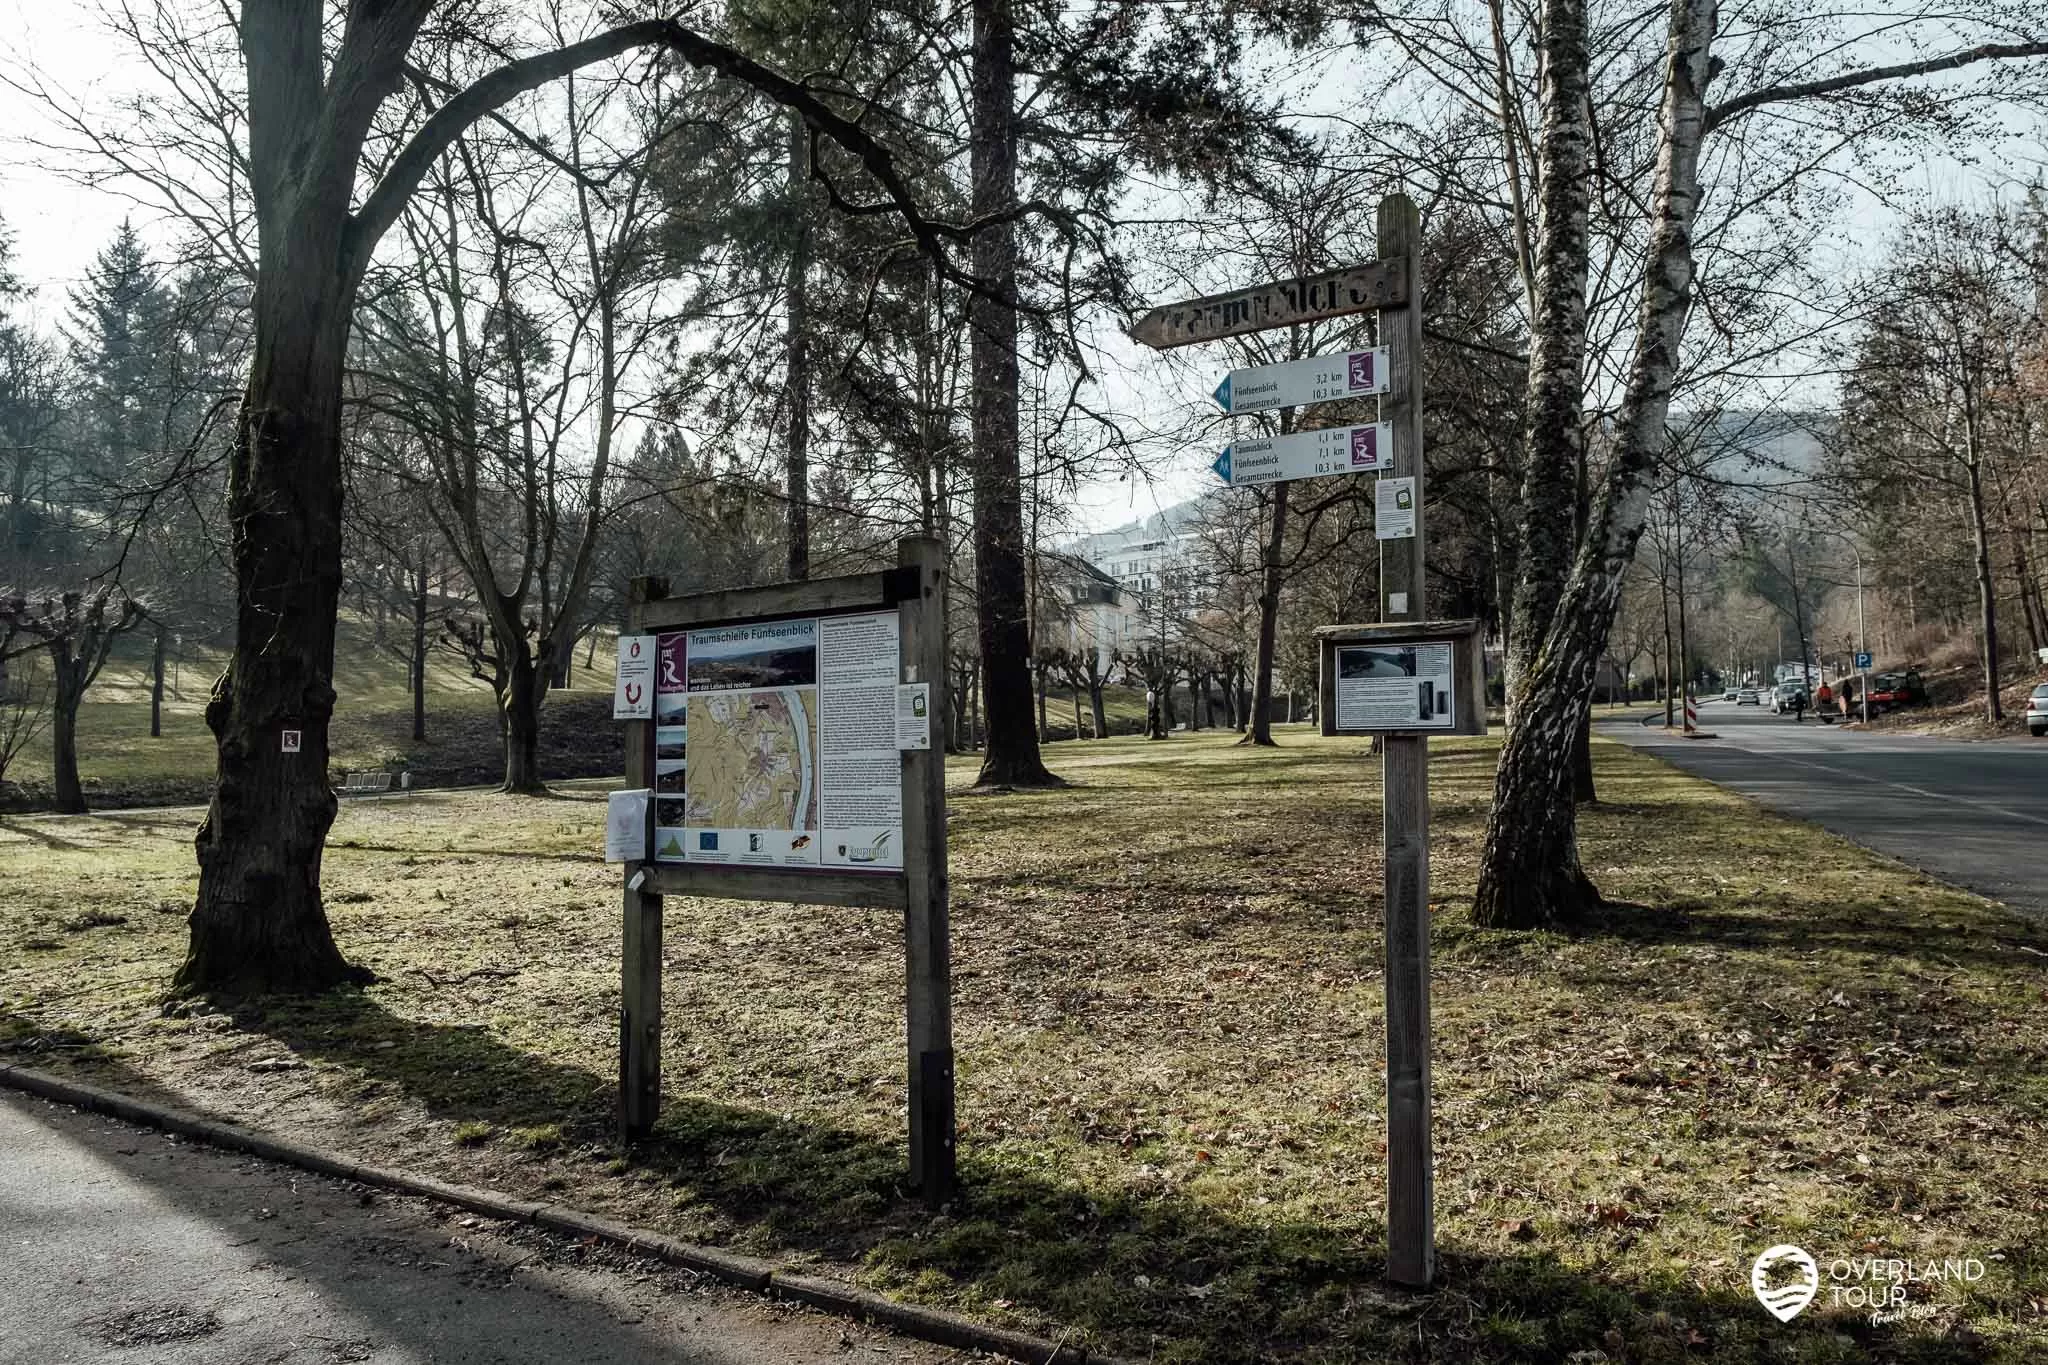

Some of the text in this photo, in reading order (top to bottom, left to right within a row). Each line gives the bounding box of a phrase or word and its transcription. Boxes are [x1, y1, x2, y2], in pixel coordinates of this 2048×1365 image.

[1316, 371, 1343, 385] 3,2 km
[1234, 382, 1343, 399] Fünfseenblick 10,3 km
[1333, 431, 1345, 441] km
[1333, 447, 1345, 457] km
[1234, 455, 1345, 474] Fünfseenblick 10,3 km
[1234, 469, 1283, 483] Gesamtstrecke
[692, 630, 749, 645] Traumschleife
[1858, 654, 1868, 666] P
